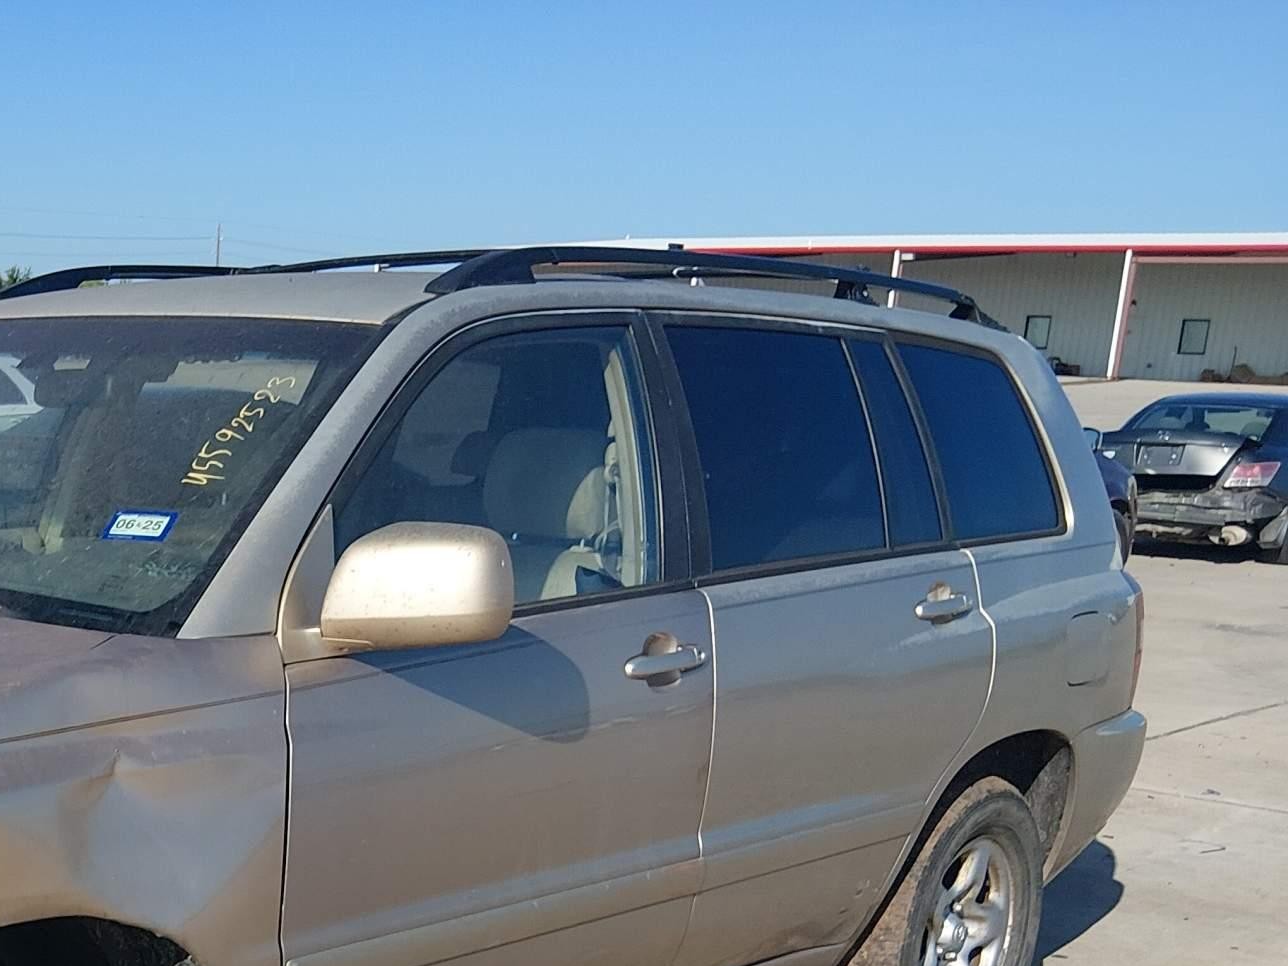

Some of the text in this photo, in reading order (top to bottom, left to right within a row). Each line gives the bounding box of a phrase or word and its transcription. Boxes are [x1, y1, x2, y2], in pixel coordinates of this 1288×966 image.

[180, 375, 296, 486] 45592523
[115, 518, 164, 531] 06 25
